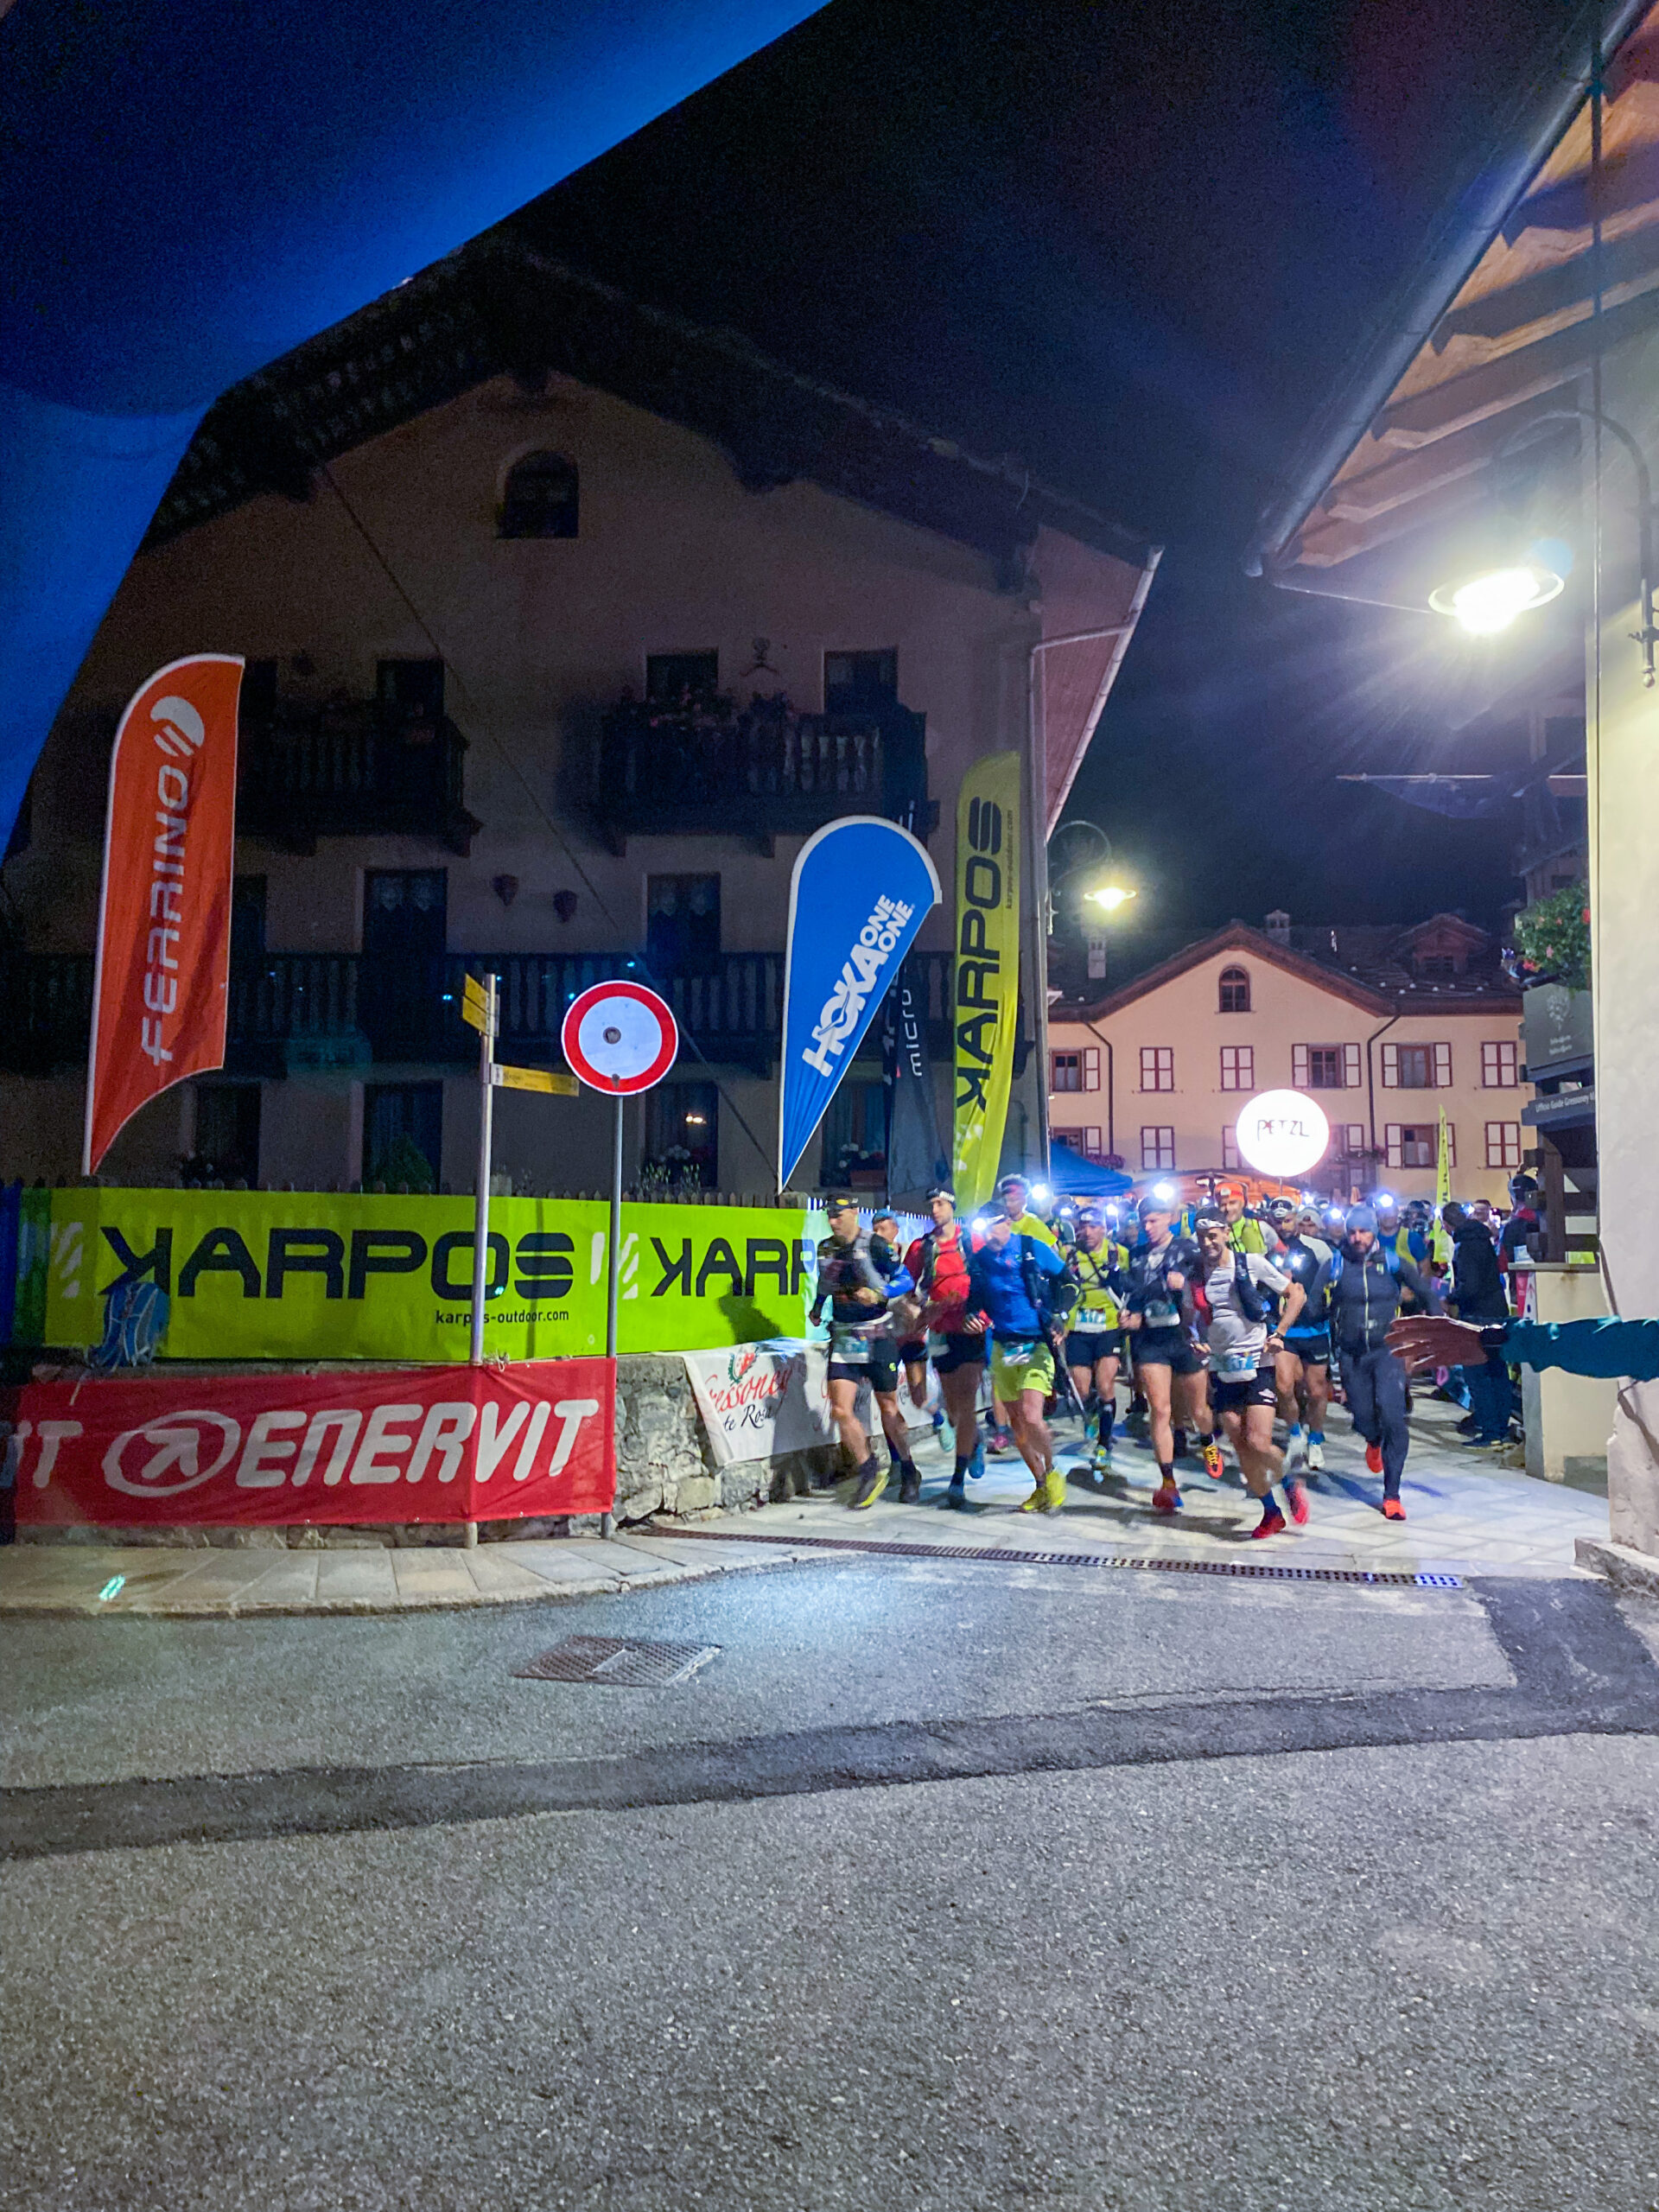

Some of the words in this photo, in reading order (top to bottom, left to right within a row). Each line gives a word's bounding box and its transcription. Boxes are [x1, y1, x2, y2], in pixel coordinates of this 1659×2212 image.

[142, 764, 189, 1066] FERRINO
[860, 894, 896, 948] ONE
[877, 899, 913, 953] ONE
[956, 796, 1002, 1115] KARPOS
[802, 944, 890, 1078] HOKA
[1256, 1119, 1310, 1141] PETZL
[99, 1225, 575, 1300] KARPOS
[649, 1236, 816, 1297] KARP
[435, 1309, 569, 1327] karps-outdoor.com
[236, 1399, 600, 1489] ENERVIT
